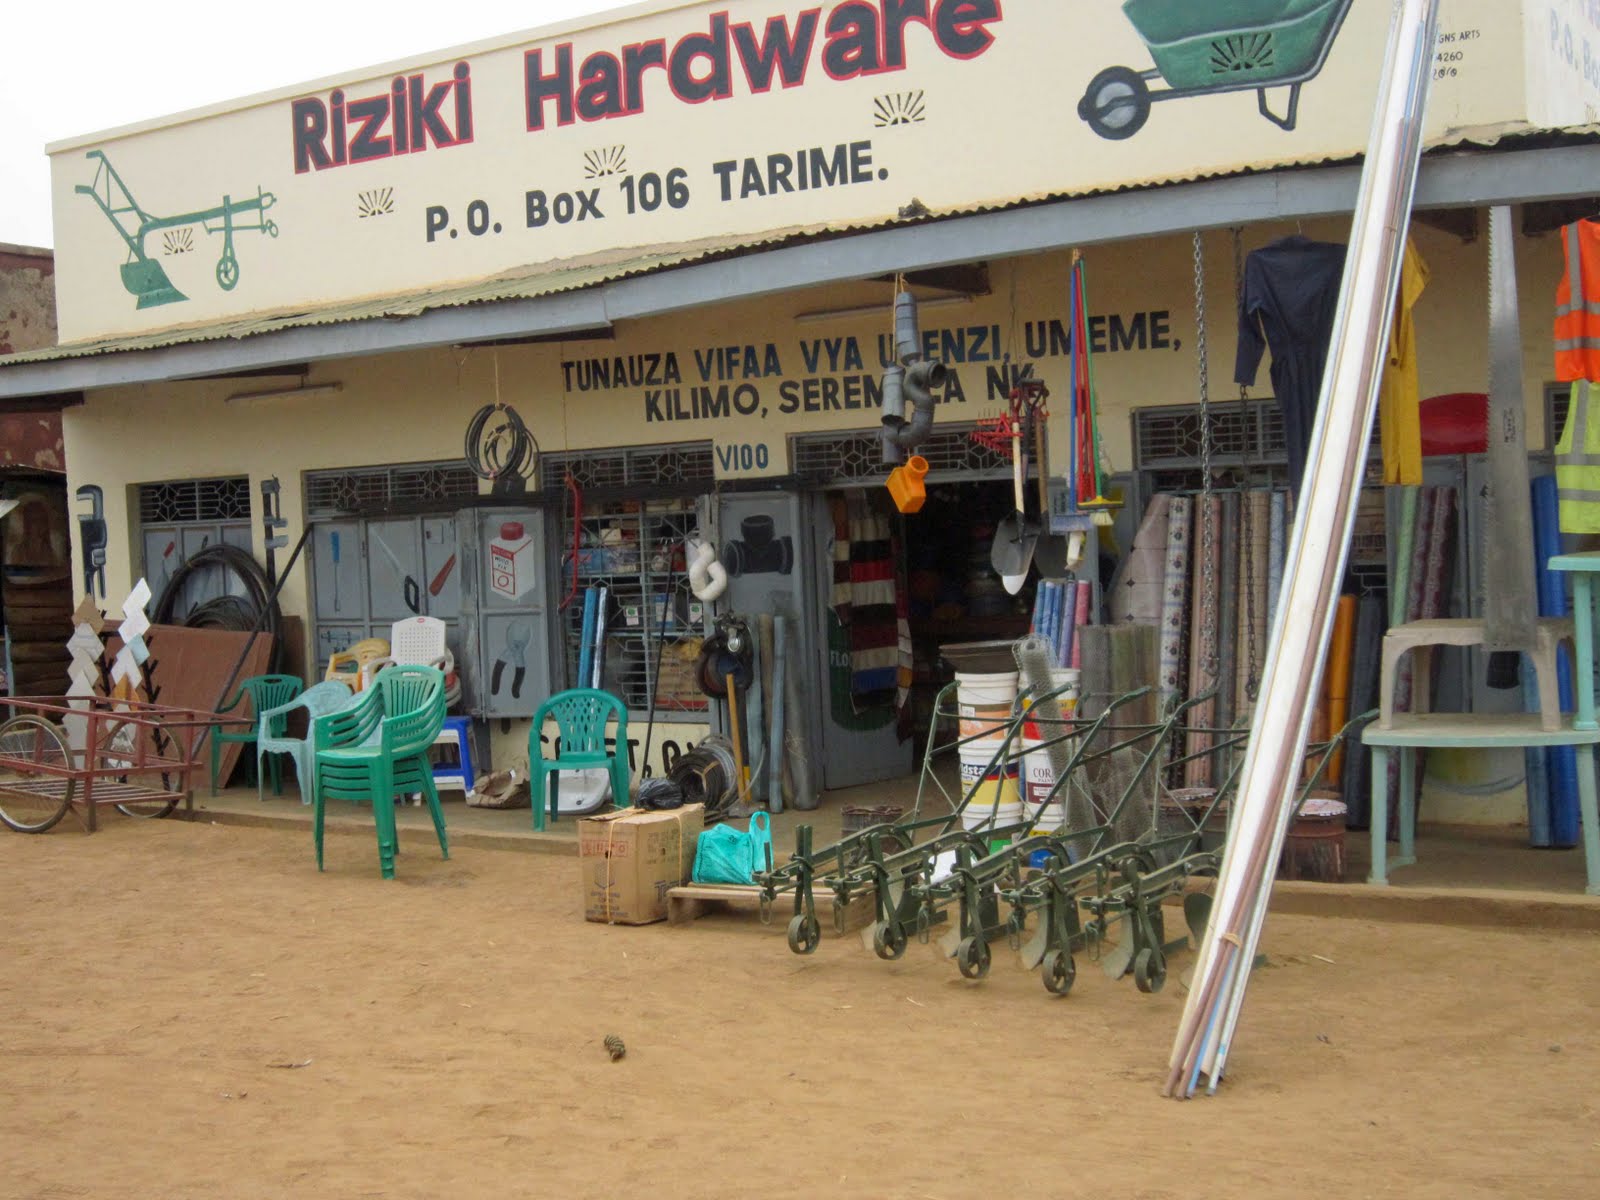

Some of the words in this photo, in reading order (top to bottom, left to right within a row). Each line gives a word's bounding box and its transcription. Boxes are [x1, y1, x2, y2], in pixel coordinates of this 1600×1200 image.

[1435, 32, 1456, 44] GNS
[1460, 29, 1481, 40] ARTS
[1435, 51, 1464, 62] 4260
[292, 61, 474, 174] Riziki
[524, 0, 1003, 132] Hardware
[525, 187, 605, 228] Box
[620, 168, 690, 214] 106
[713, 140, 889, 201] TARIME.
[561, 352, 682, 392] TUNAUZA
[694, 344, 783, 382] VIFAA
[800, 337, 864, 373] VYA
[878, 323, 1011, 369] UENZI,
[644, 383, 768, 422] KILIMO,
[779, 368, 967, 413] SEREMA
